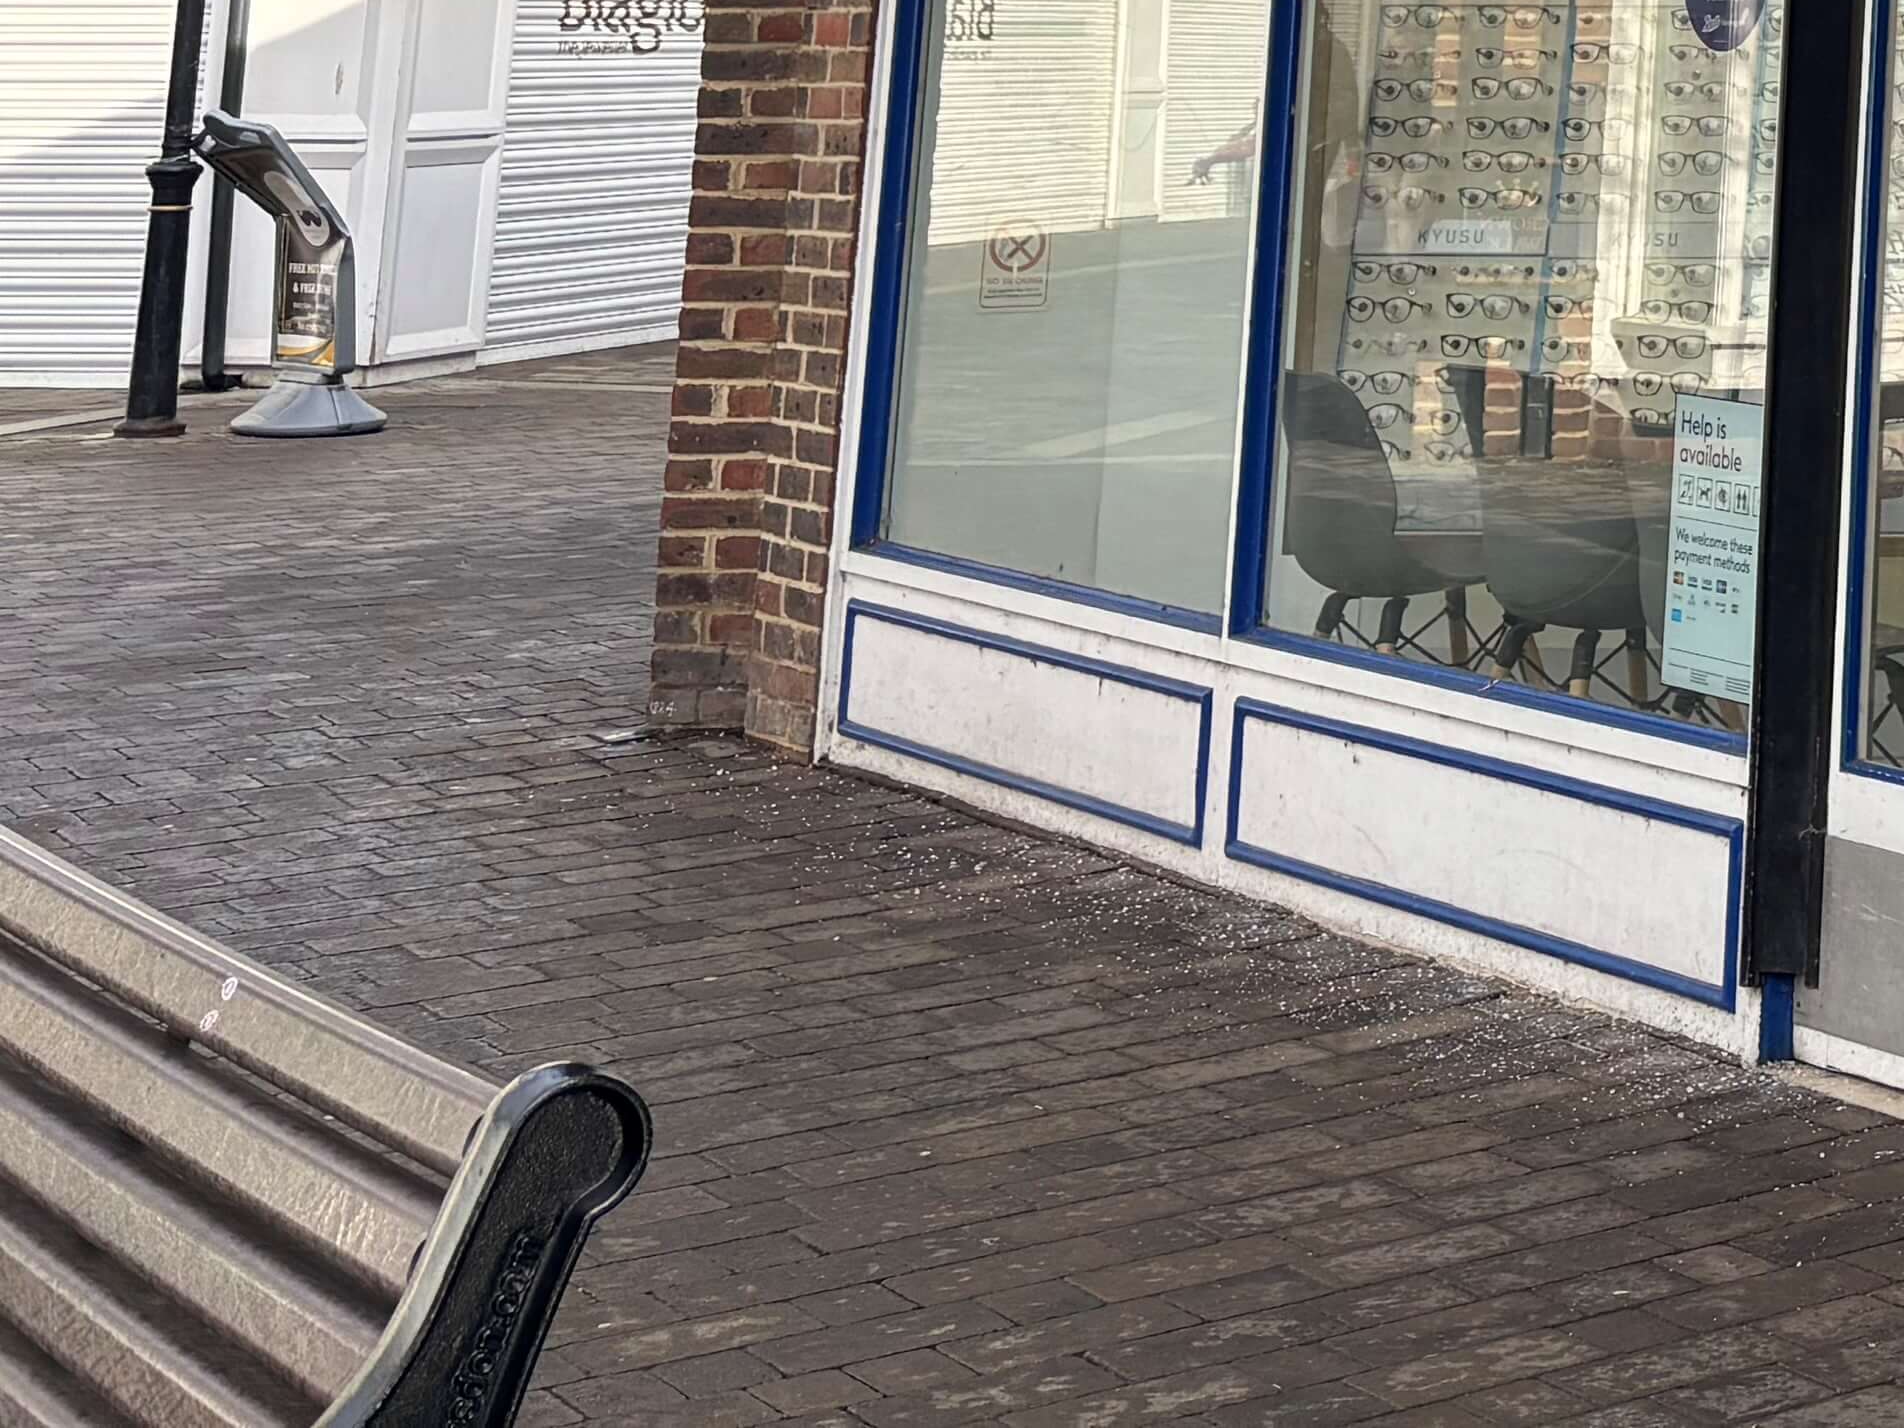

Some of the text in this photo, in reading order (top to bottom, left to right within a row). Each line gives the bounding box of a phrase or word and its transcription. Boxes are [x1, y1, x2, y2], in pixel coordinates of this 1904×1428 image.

[1417, 230, 1485, 244] KYUSU
[1680, 411, 1727, 442] Help is
[1679, 444, 1742, 472] available
[1675, 526, 1753, 555] We welcome these
[1674, 547, 1750, 574] payment methods
